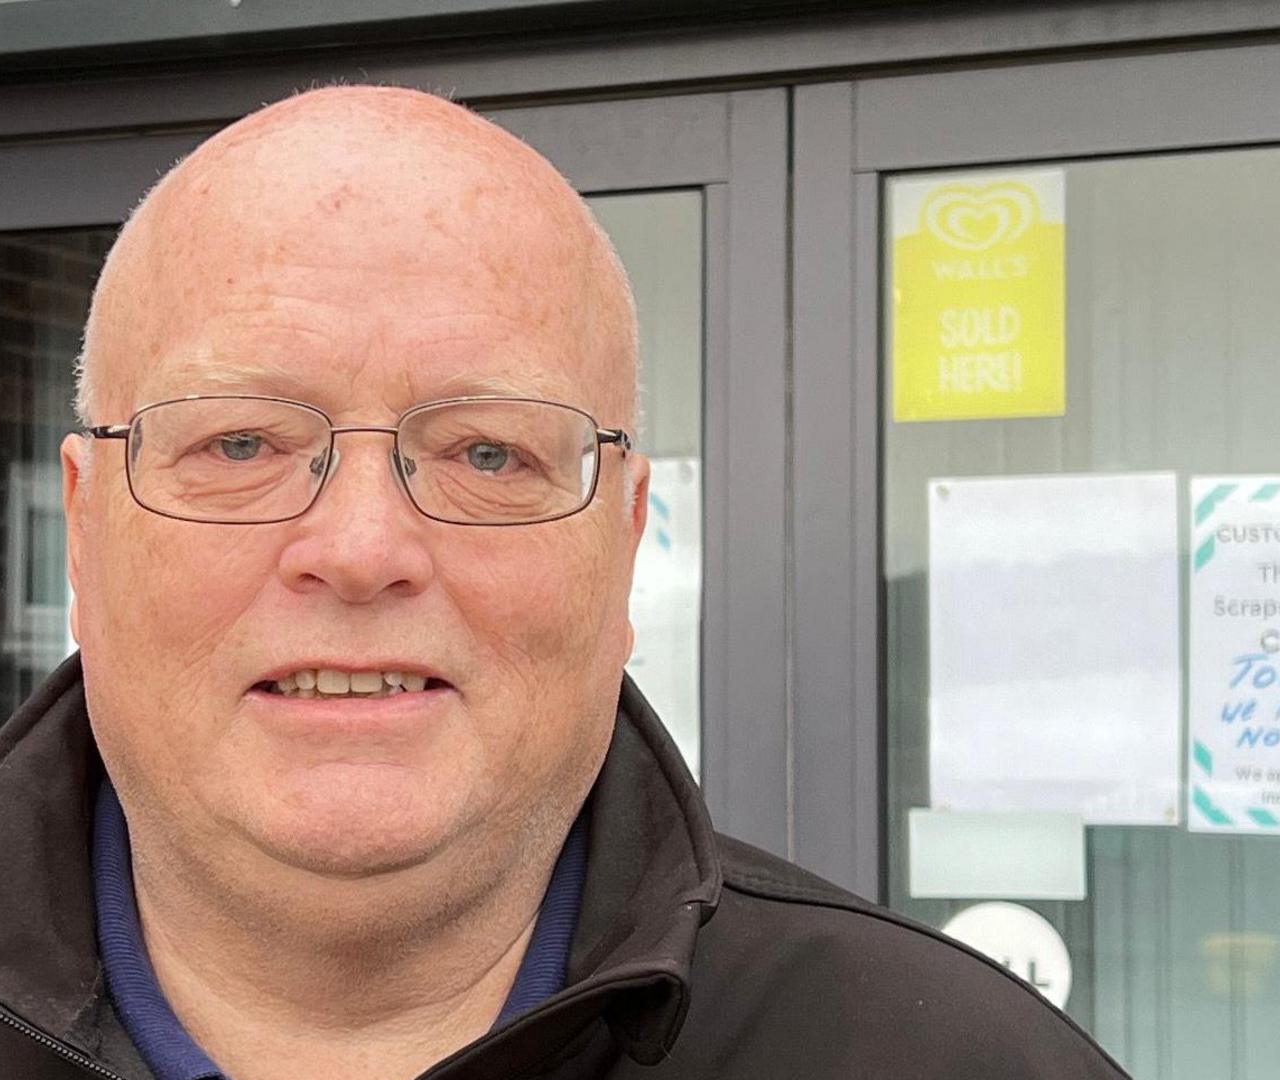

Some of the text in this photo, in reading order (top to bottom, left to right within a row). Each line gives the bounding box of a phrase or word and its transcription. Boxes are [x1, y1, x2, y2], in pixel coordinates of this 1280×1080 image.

[938, 304, 1021, 348] SOLD
[937, 350, 1022, 395] HERE!
[1235, 767, 1262, 782] We
